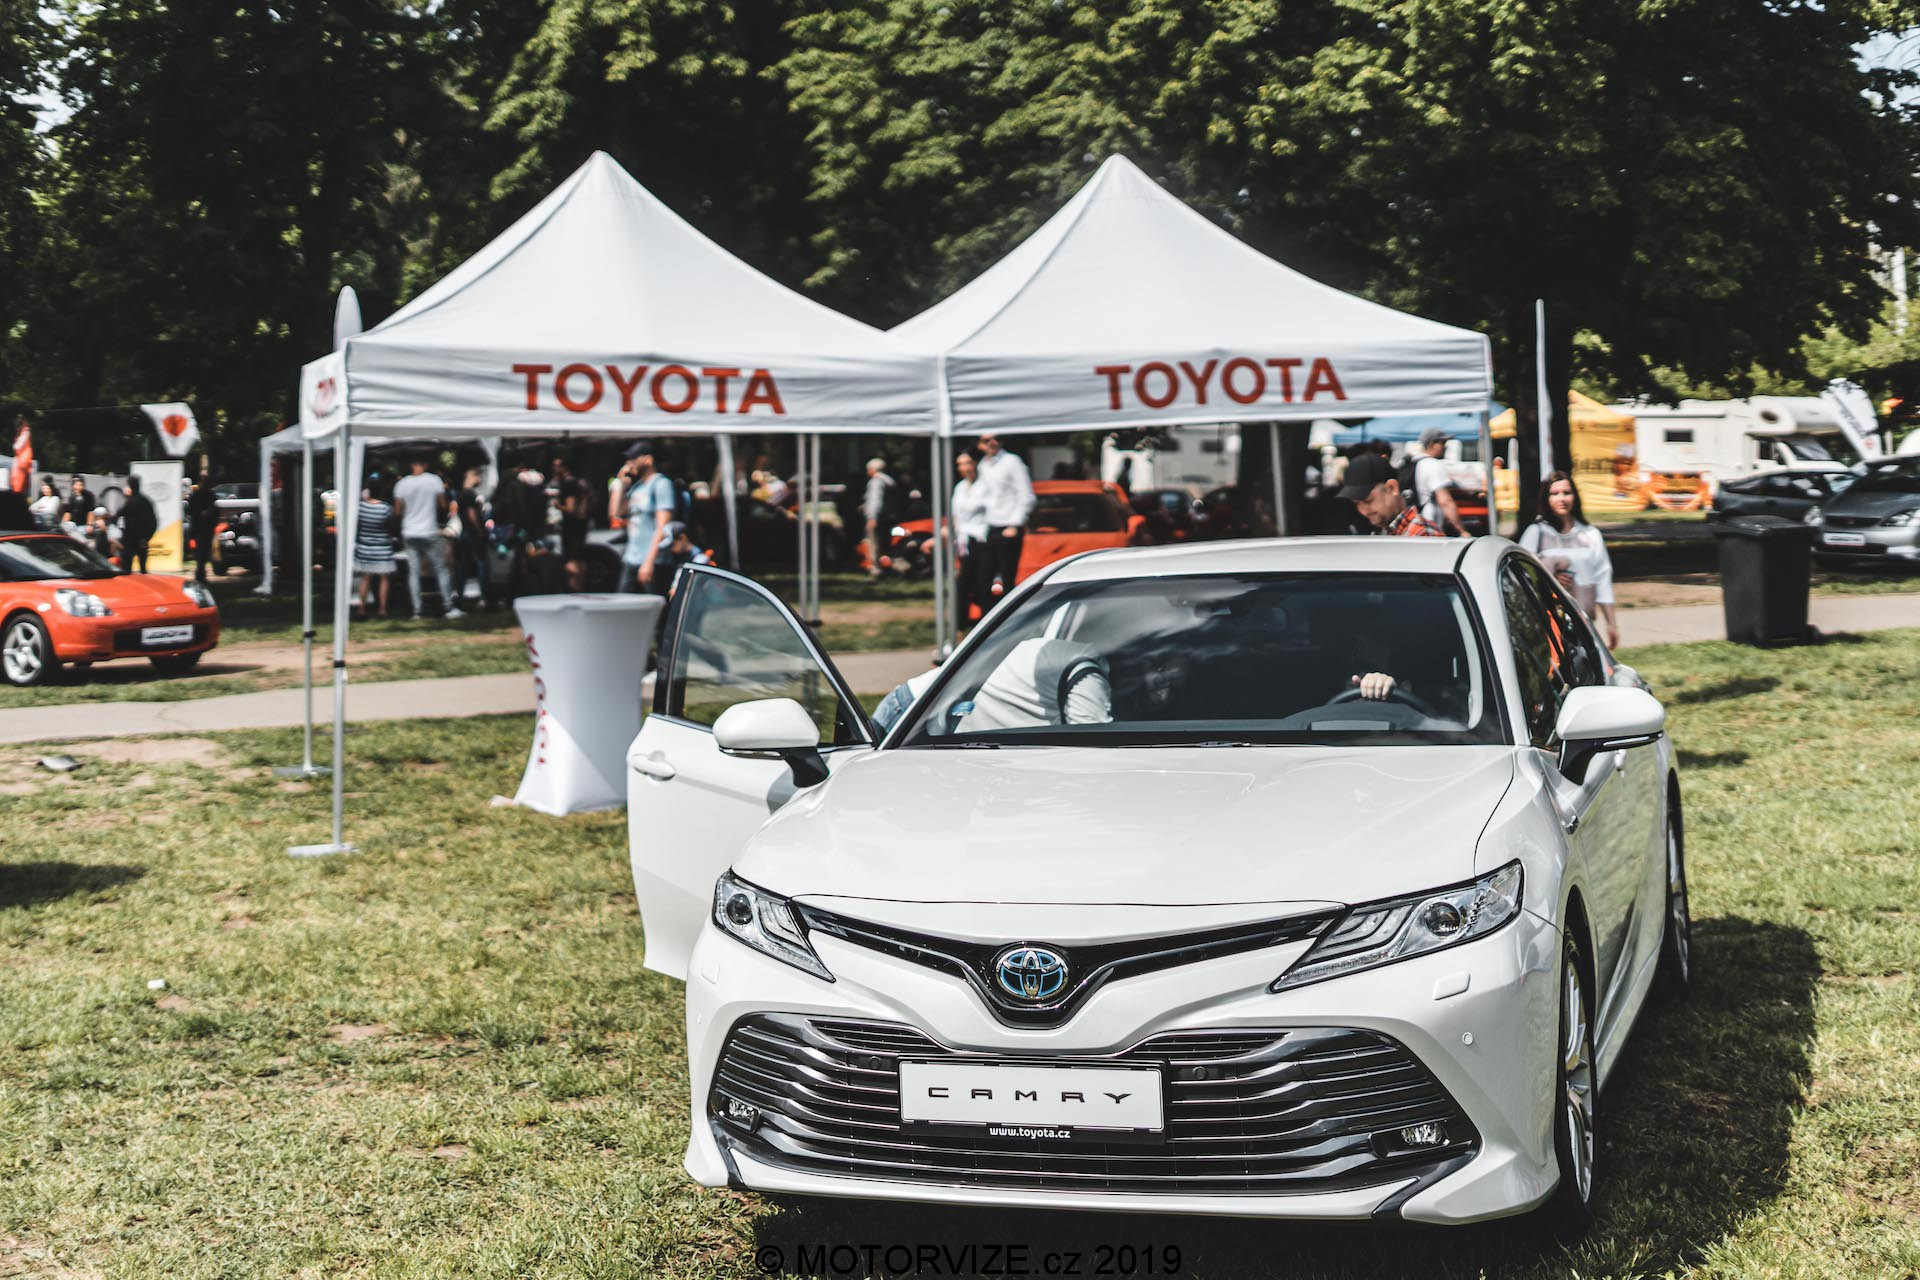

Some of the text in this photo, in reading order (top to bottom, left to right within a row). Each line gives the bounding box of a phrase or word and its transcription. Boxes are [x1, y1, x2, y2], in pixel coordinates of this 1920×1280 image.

[512, 363, 786, 414] TOYOTA
[1095, 357, 1347, 410] TOYOTA
[928, 1087, 1132, 1104] CAMRY
[989, 1127, 1071, 1140] www.toyota.cz
